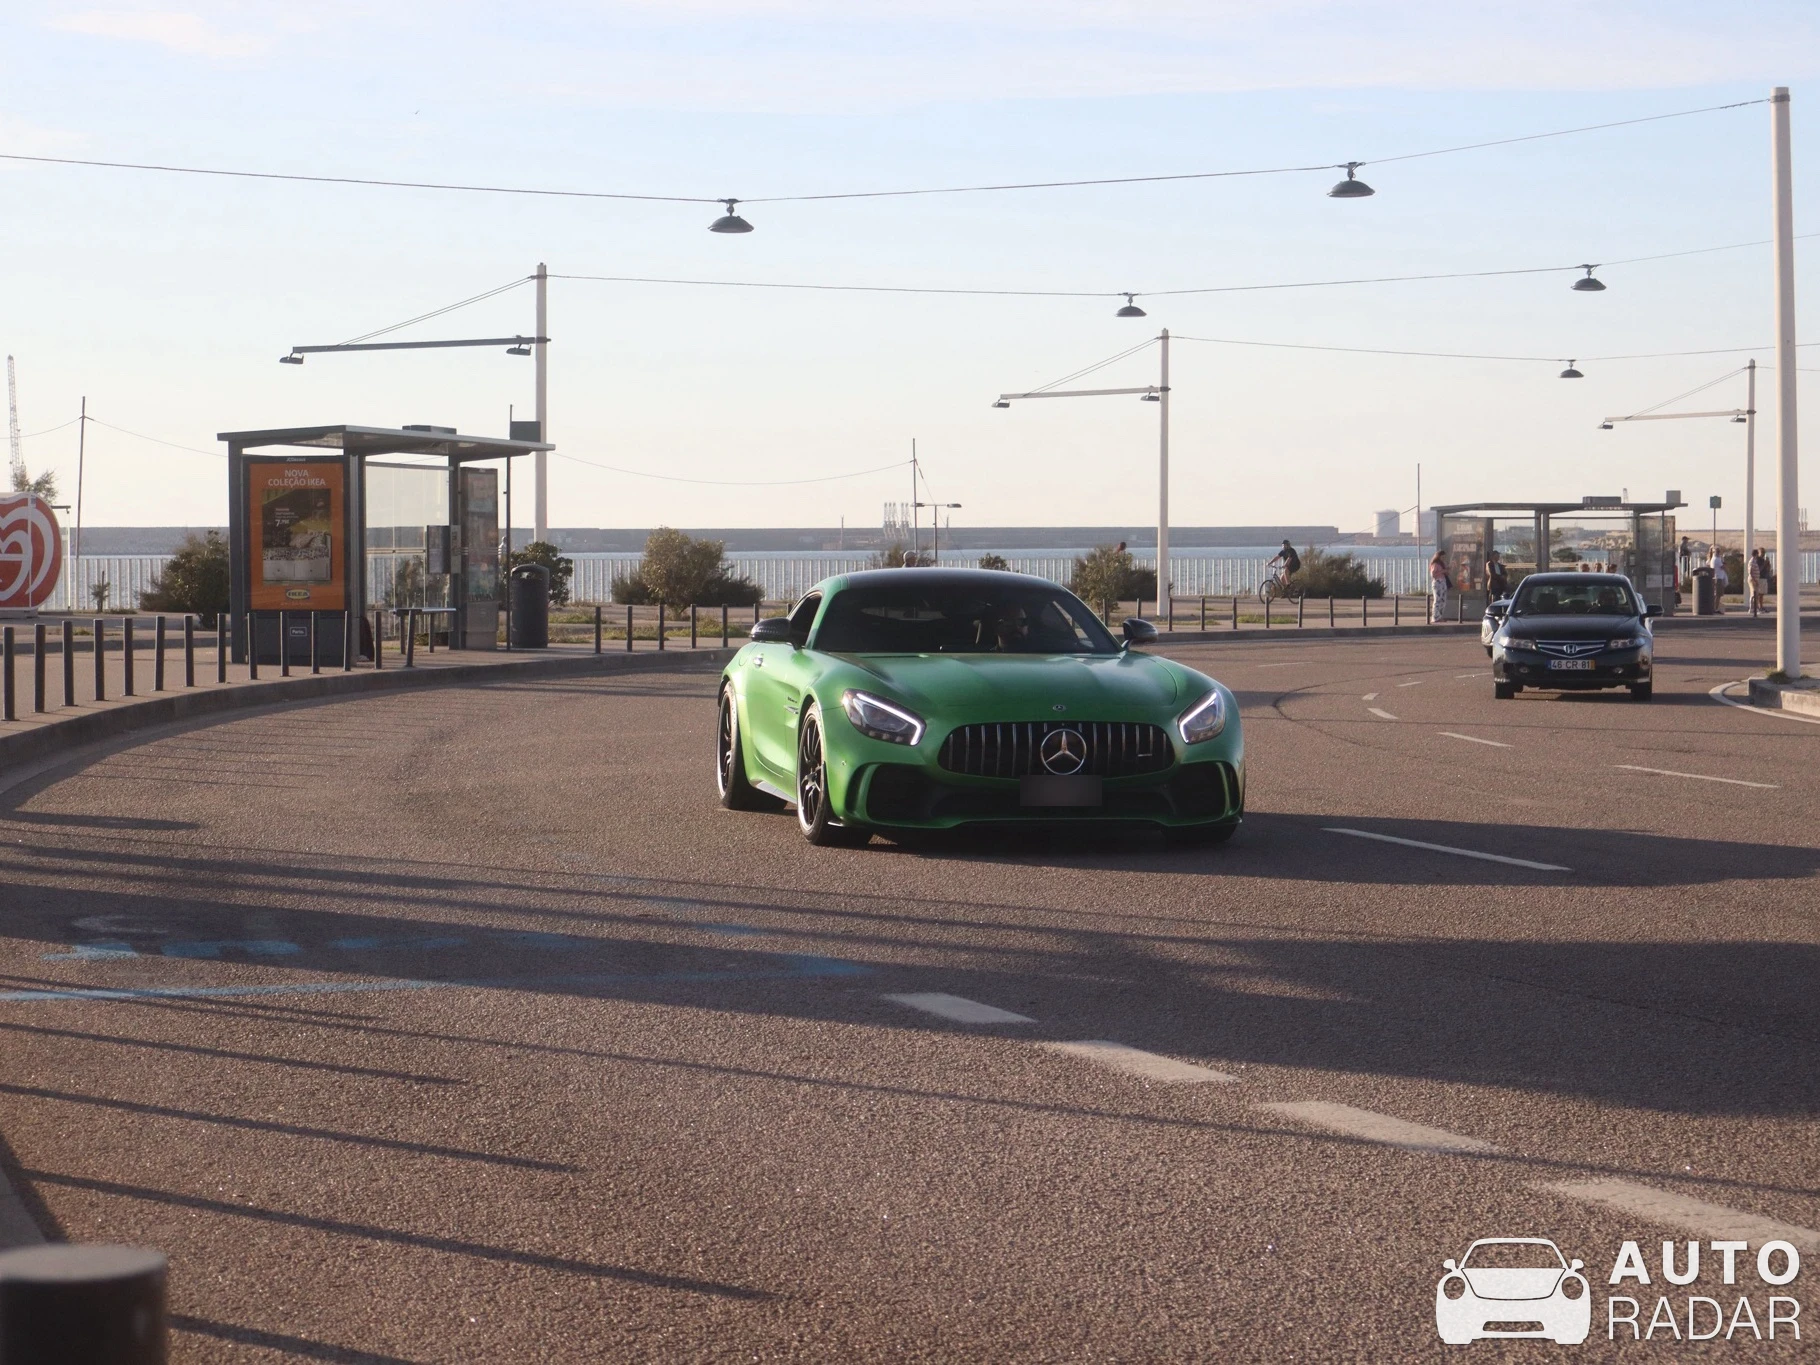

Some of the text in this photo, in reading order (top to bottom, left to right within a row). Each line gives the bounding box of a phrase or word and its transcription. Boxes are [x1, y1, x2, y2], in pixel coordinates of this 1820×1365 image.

[284, 469, 309, 477] NOVA
[268, 477, 326, 488] COLEÇÃO IKEA
[1565, 660, 1578, 669] CR
